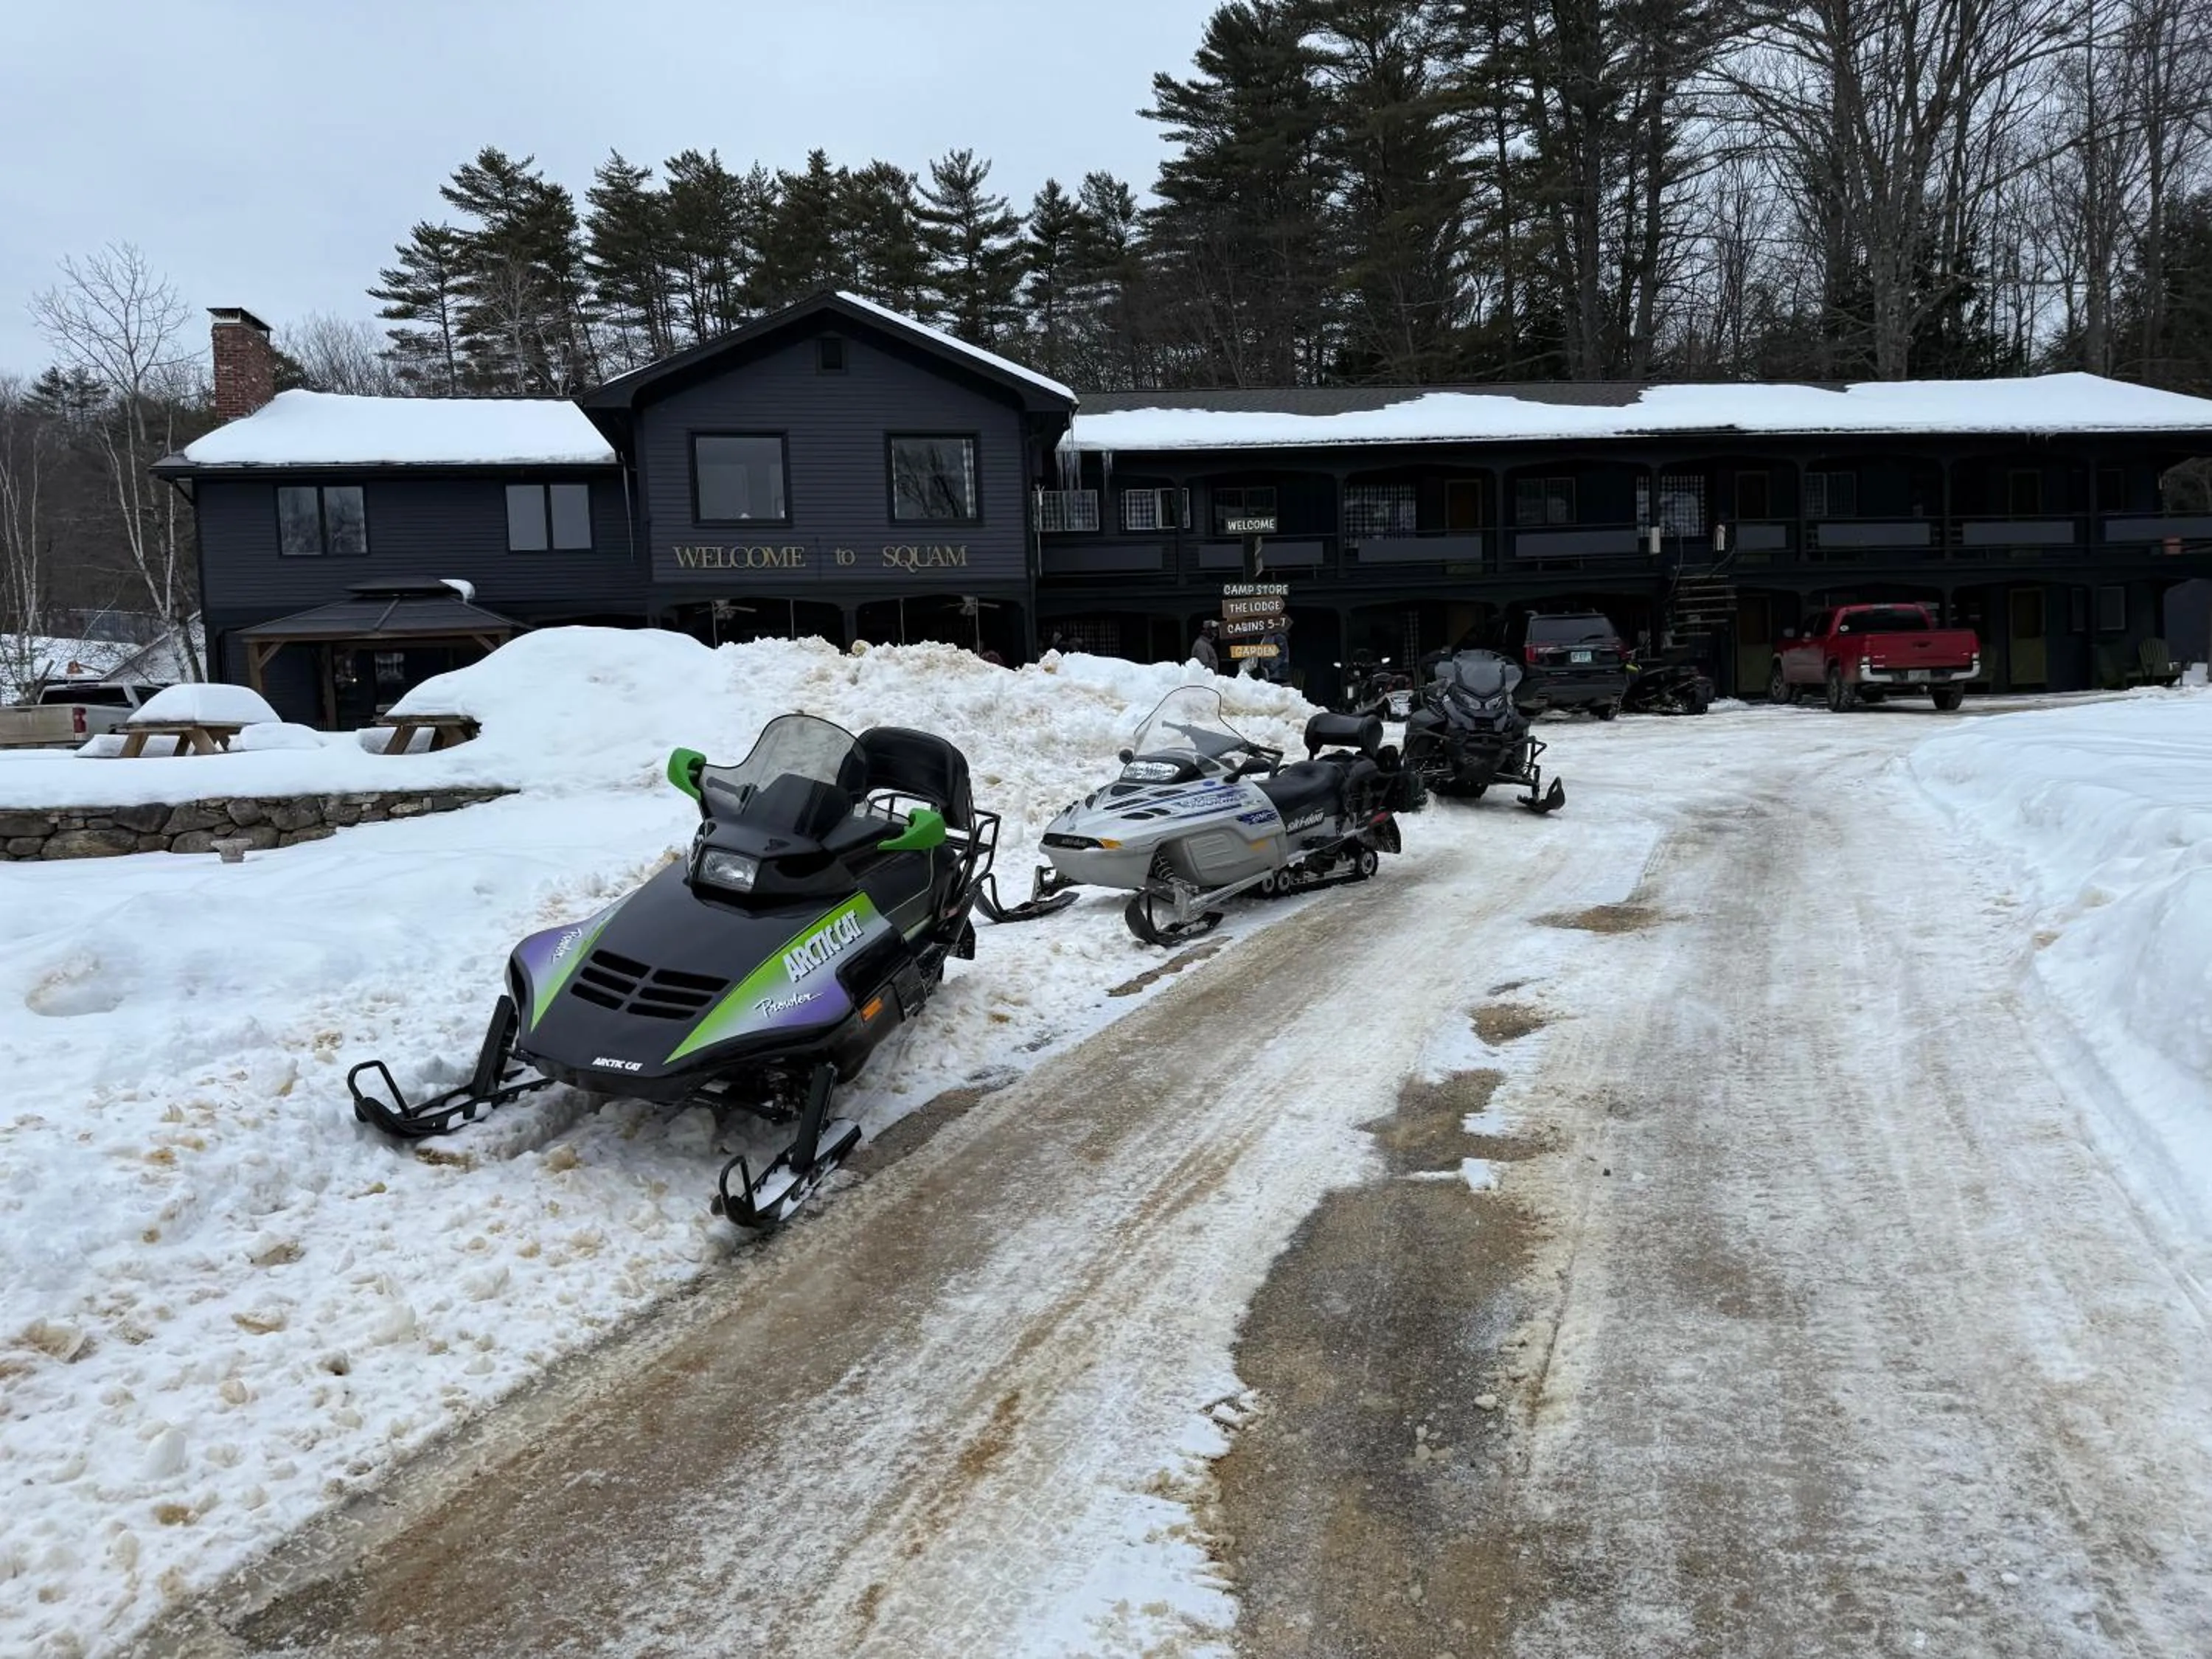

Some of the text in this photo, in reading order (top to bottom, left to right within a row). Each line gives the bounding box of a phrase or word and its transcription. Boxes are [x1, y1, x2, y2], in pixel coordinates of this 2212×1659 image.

[1228, 518, 1275, 531] WELCOME
[672, 545, 968, 574] WELCOME to SQUAM
[1223, 583, 1289, 596] CAMP STORE
[1229, 600, 1281, 613] THE LODGE
[1226, 617, 1287, 634] CABINS 5-7
[1235, 646, 1276, 657] GARDEN
[783, 908, 865, 984] ARCTIC CAT
[753, 992, 824, 1018] Prowler
[591, 1057, 644, 1072] ARCTIC CAT
